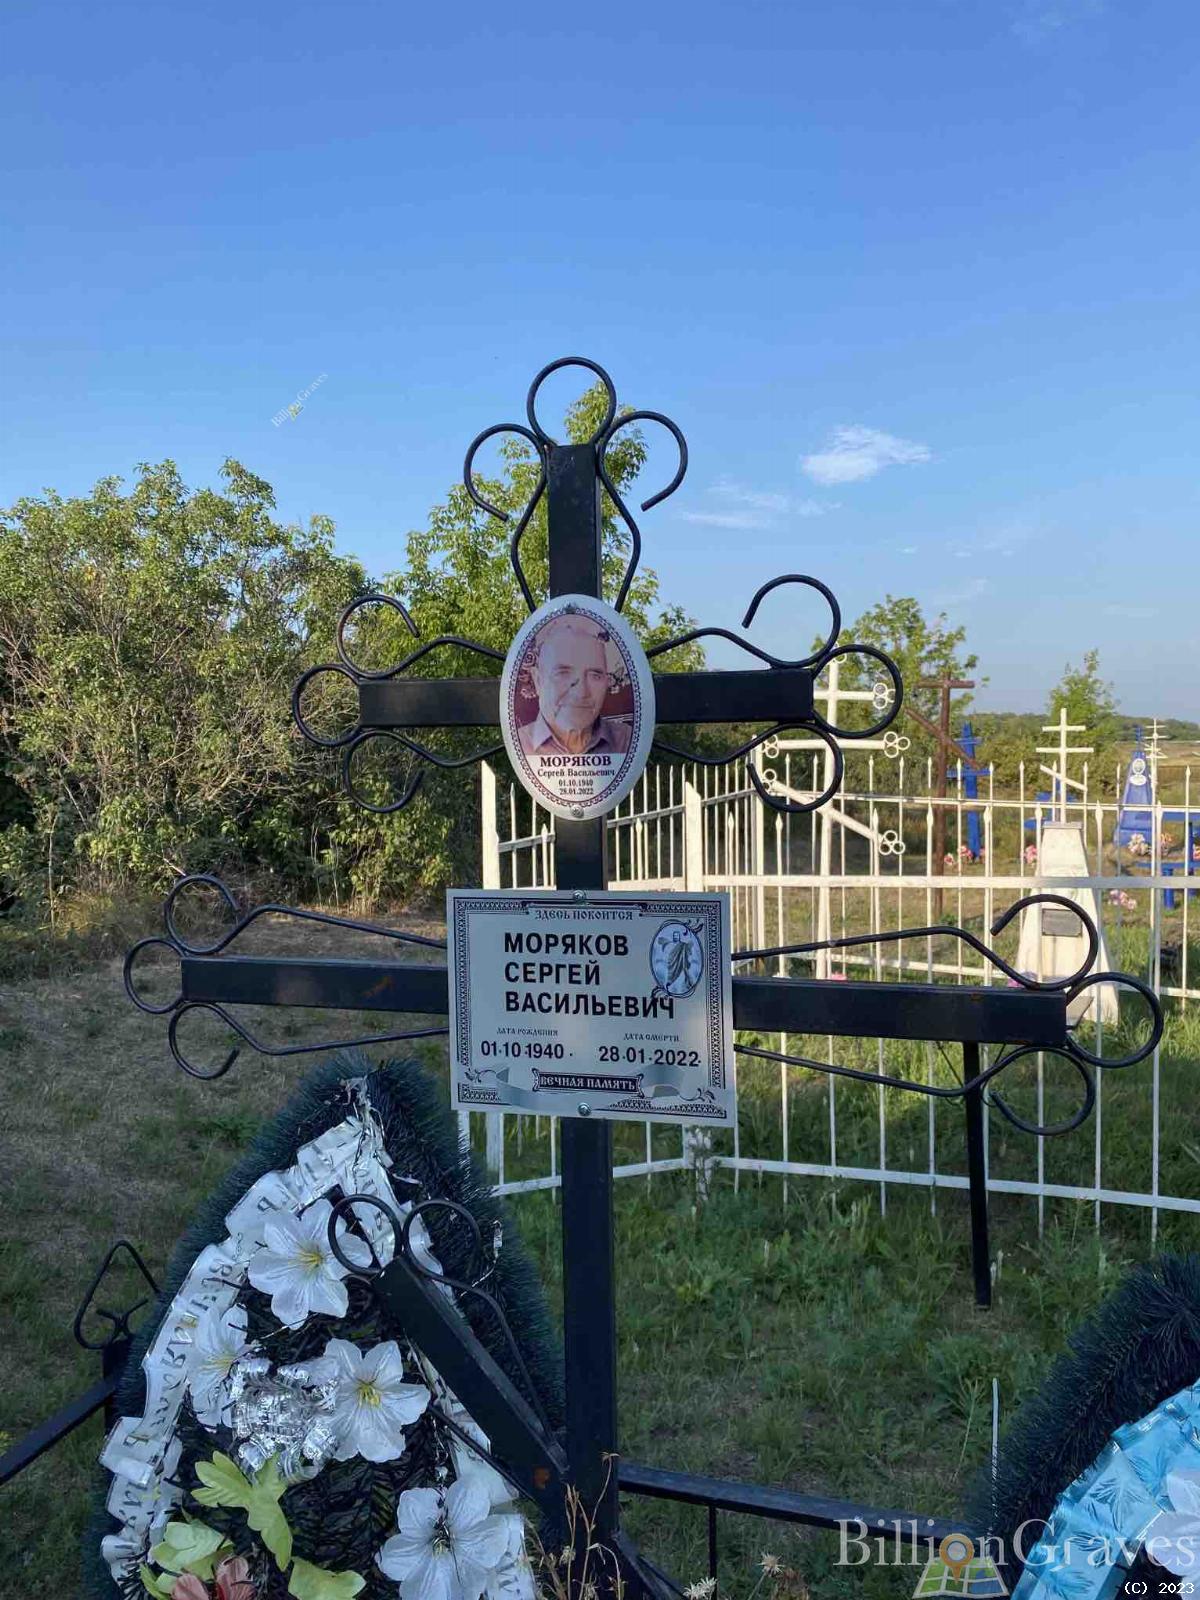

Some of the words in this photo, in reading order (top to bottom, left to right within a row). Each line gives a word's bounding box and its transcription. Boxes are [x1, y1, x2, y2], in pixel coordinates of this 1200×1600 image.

[541, 756, 611, 767] МОРЯКОВ
[537, 769, 565, 779] Сергей
[568, 768, 615, 777] Васильевич
[558, 779, 594, 787] 01.10.1940
[535, 909, 571, 920] ЗДЕСЬ
[573, 909, 633, 921] ПОКОИТСЯ
[504, 932, 629, 956] МОРЯКОВ
[505, 960, 600, 985] СЕРГЕЙ
[505, 991, 675, 1019] ВАСИЛЬЕВИЧ
[496, 1027, 516, 1036] ДАТА
[623, 1032, 644, 1041] ДАТА
[540, 1075, 585, 1088] ВЕЧНАЯ
[587, 1077, 636, 1091] ПАМЯТЬ
